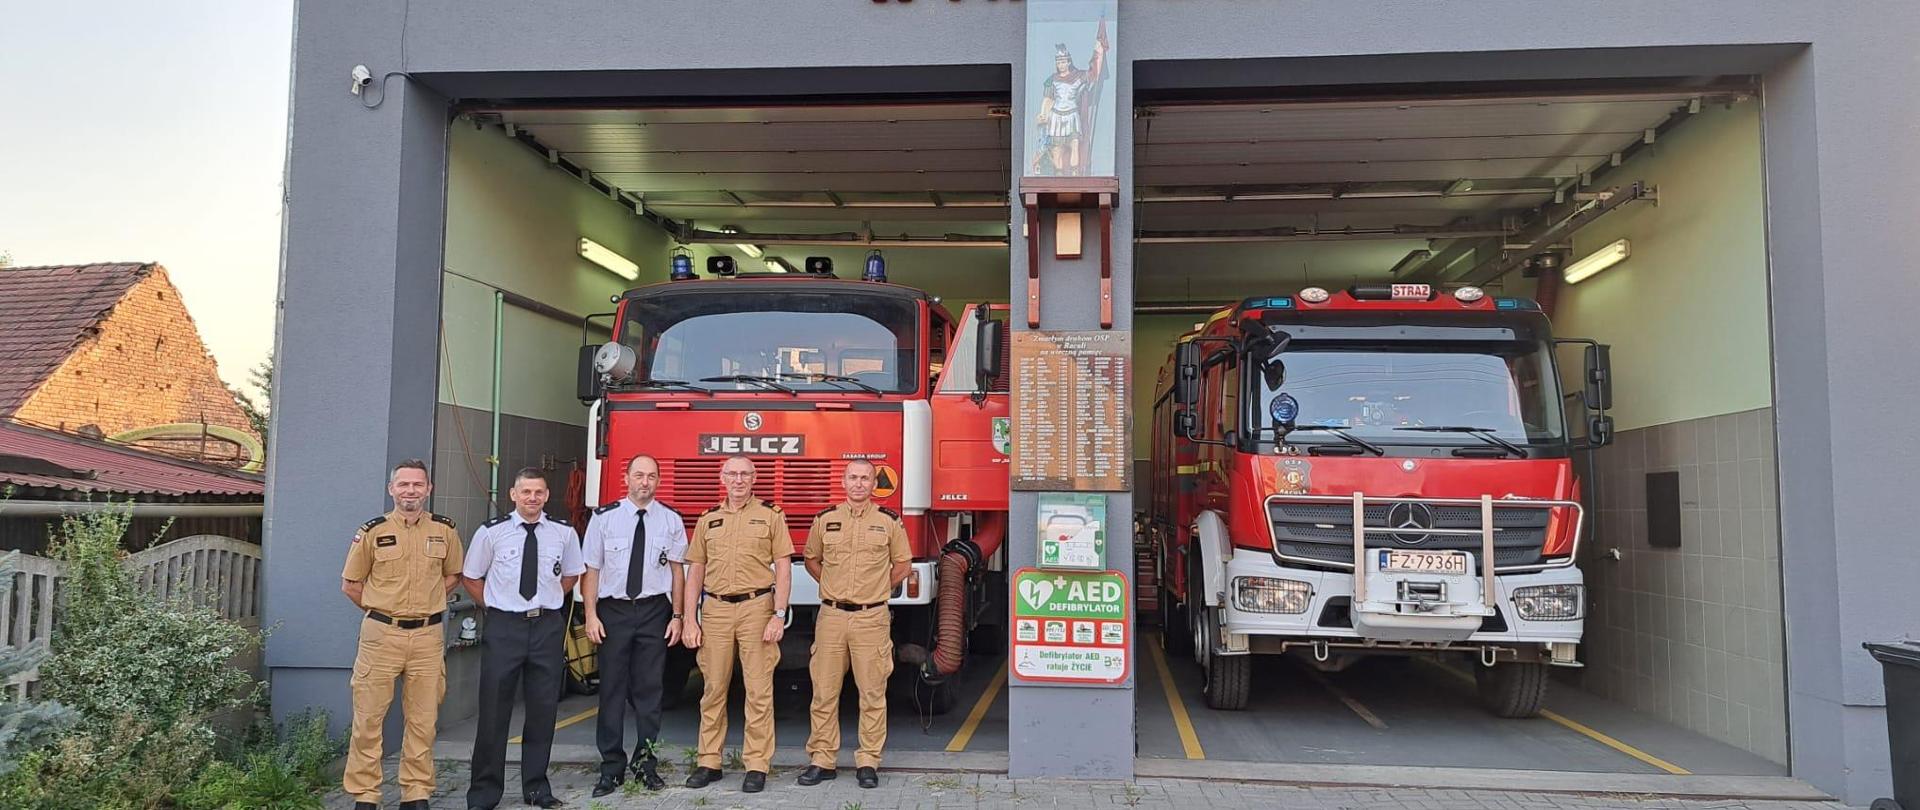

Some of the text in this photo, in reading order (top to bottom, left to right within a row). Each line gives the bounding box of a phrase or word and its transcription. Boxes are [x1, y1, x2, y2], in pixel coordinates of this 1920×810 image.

[704, 436, 799, 454] JELCZ
[1390, 554, 1463, 570] FZ 7936H
[1067, 580, 1121, 602] AED
[1049, 603, 1120, 613] DEFIBRYLATOR
[1039, 650, 1100, 661] Defibrylator AED
[1046, 662, 1093, 673] ratuje ŻYCIE
